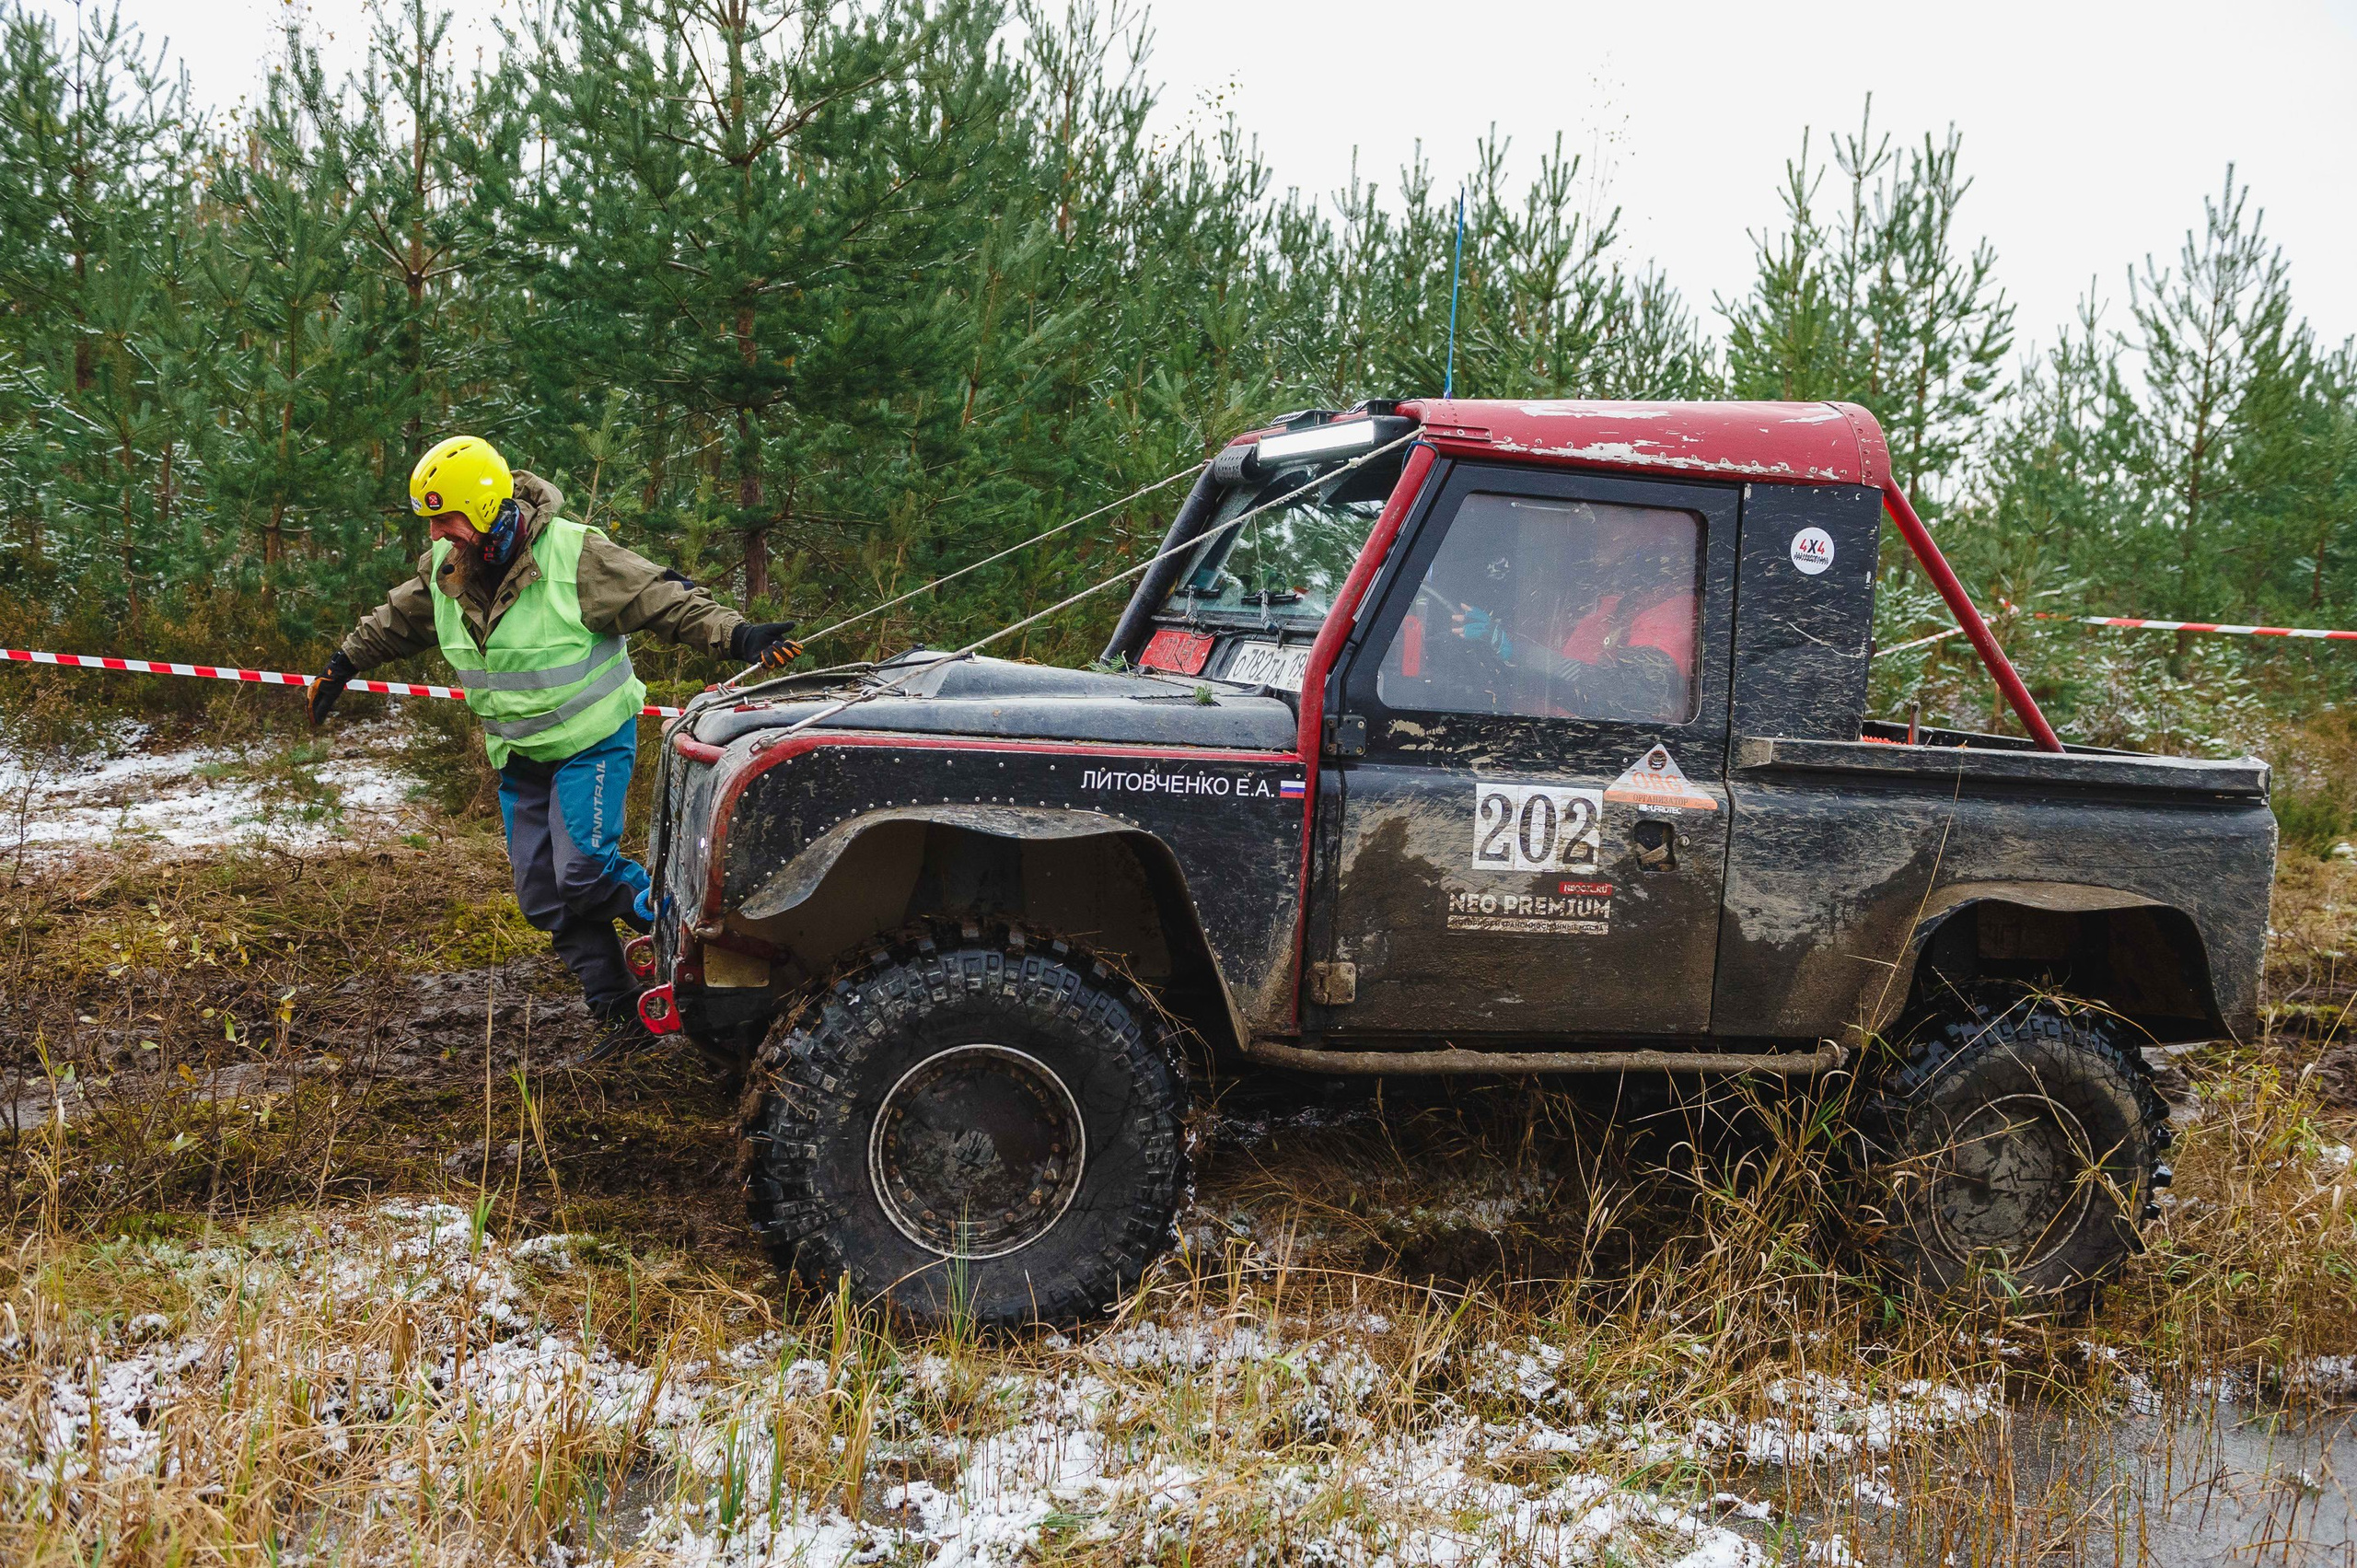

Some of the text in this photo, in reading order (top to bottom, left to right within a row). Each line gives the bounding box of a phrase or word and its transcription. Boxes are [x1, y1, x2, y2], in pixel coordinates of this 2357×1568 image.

[1081, 771, 1275, 797] ЛИТОВЧЕНКО Е.А.
[1631, 772, 1684, 795] ORG
[591, 760, 606, 849] FINNTRAIL
[1632, 793, 1689, 807] ОРГАНИЗАТОР
[1478, 792, 1598, 865] 202
[1448, 893, 1611, 919] NEO PREMIUM
